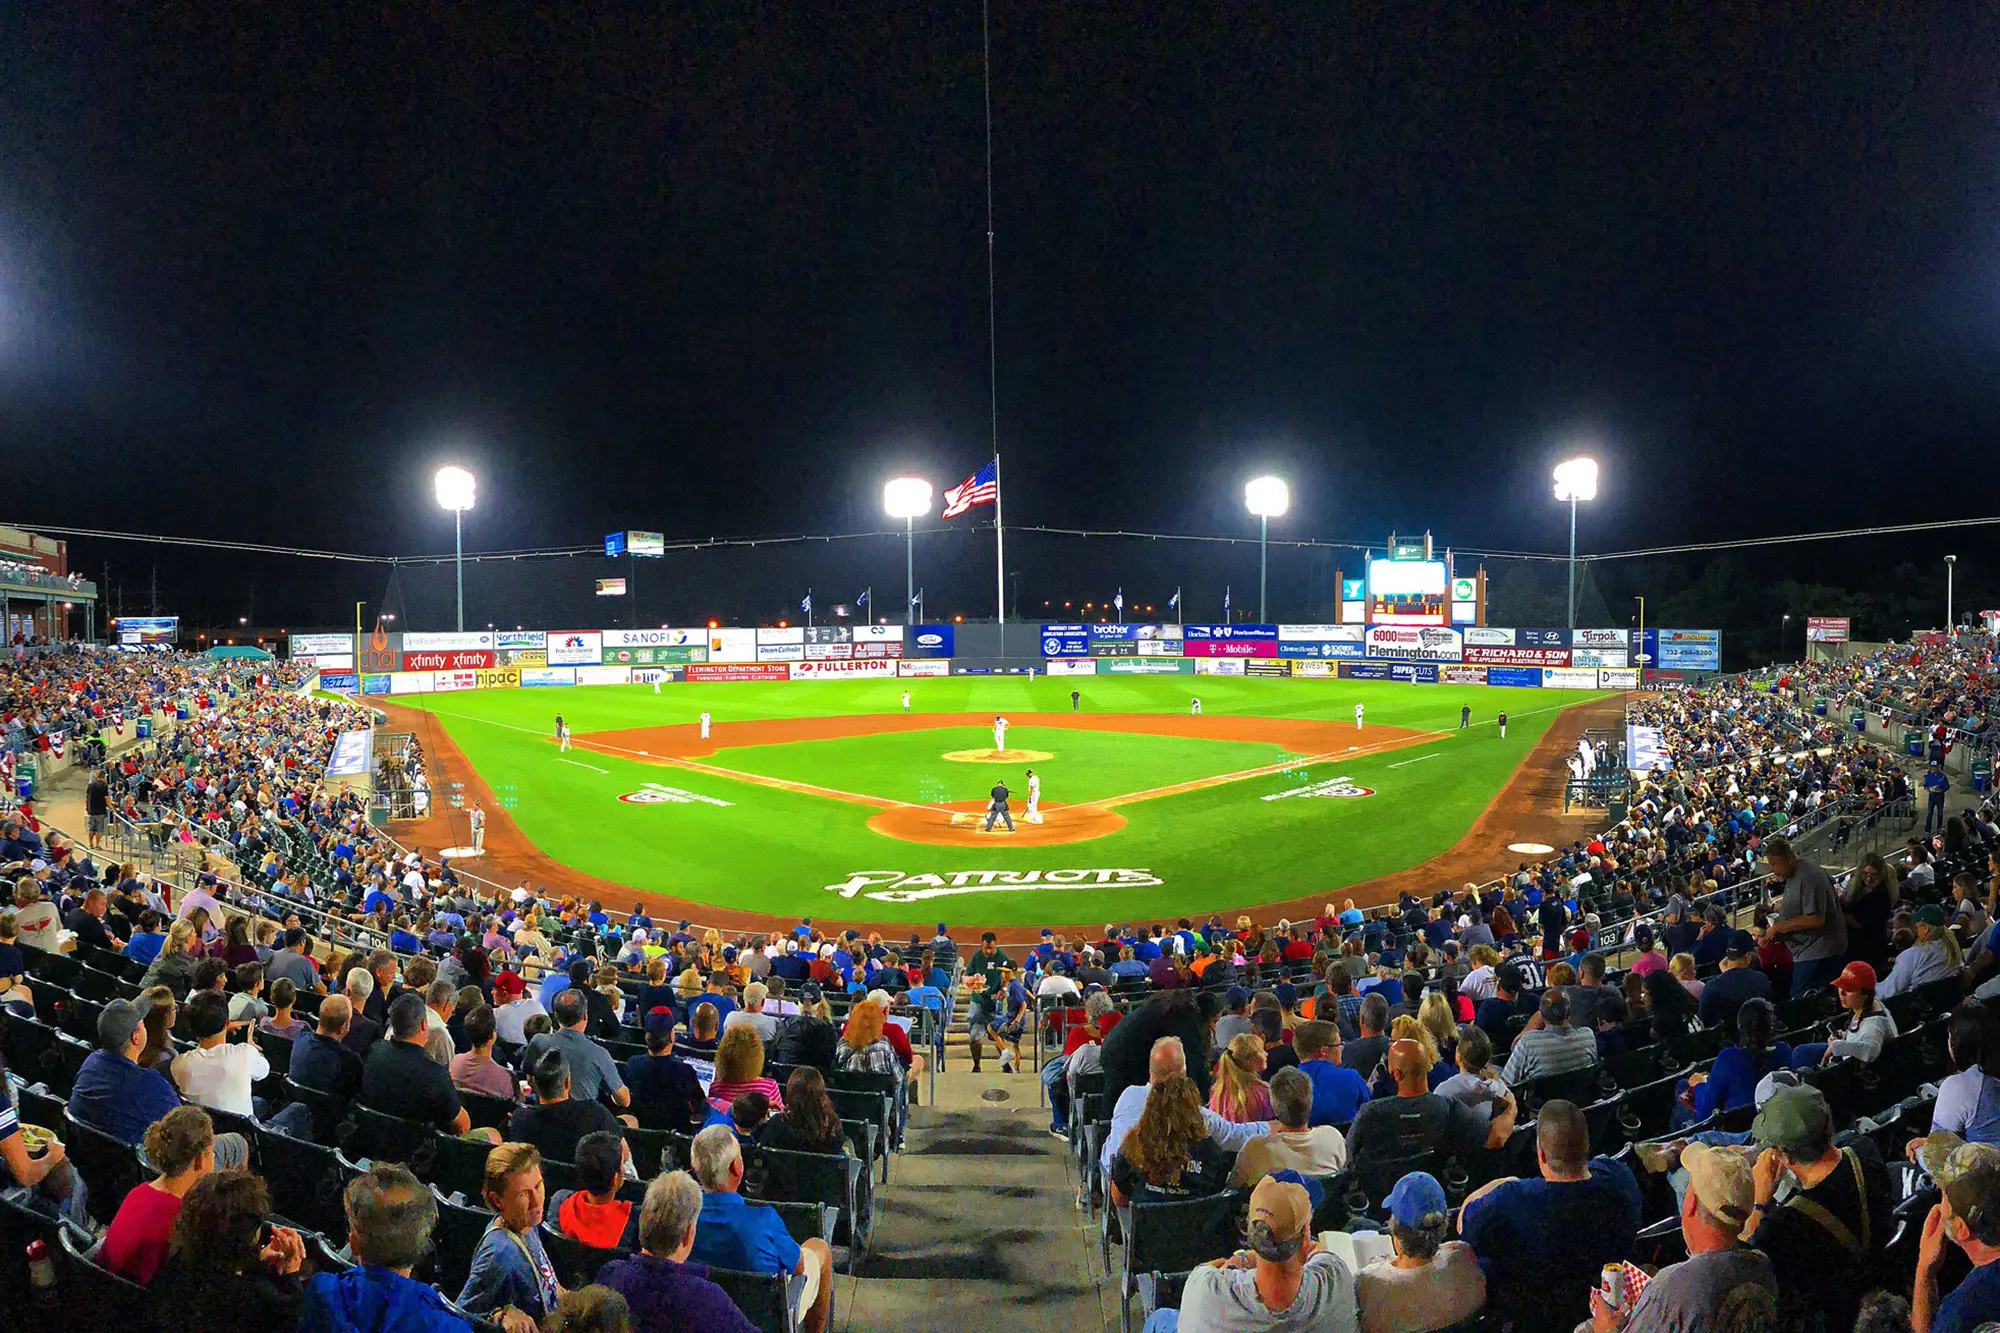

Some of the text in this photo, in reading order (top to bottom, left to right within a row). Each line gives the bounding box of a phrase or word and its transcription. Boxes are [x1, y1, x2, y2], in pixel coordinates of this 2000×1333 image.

[1094, 625, 1129, 634] brother
[496, 632, 545, 642] Northfield
[623, 632, 670, 644] SANOFI
[1373, 630, 1397, 641] 6000
[1582, 630, 1616, 642] Tirpok
[1368, 645, 1460, 660] Flemington.com
[1481, 649, 1535, 658] RICHARD
[1545, 651, 1569, 659] SON
[410, 652, 487, 670] xfinity xfinity
[817, 661, 887, 672] FULLERTON
[1296, 662, 1304, 670] 22
[688, 665, 727, 673] FLEMINGTON
[728, 664, 765, 673] DEPARTMENT
[1392, 666, 1433, 676] SUPERCUTS
[824, 869, 1165, 901] PATRIOTS
[371, 937, 387, 950] 104
[1600, 934, 1616, 946] 103
[1518, 963, 1543, 990] 31
